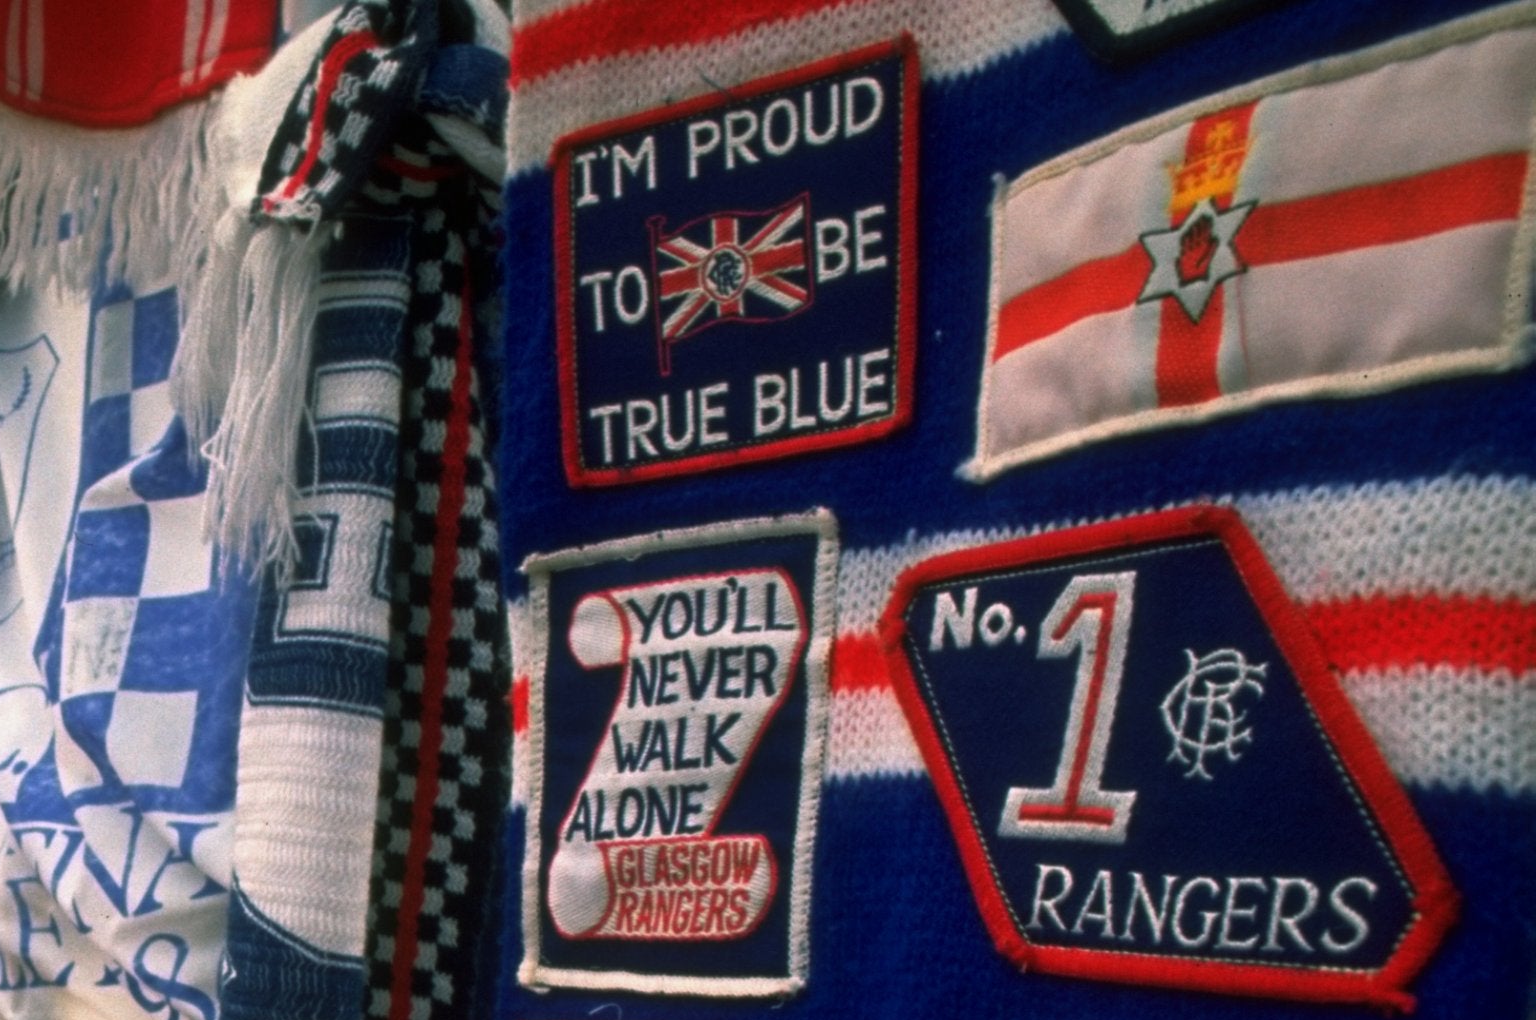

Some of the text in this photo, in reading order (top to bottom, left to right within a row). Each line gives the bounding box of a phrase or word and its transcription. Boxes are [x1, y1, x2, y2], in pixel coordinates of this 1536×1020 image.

[575, 77, 885, 207] I'M PROUD
[579, 265, 649, 332] TO
[814, 205, 889, 283] BE
[590, 348, 890, 463] TRUE BLUE
[628, 576, 795, 645] YOU'LL
[627, 645, 779, 708] NEVER
[928, 571, 1138, 845] No. 1
[611, 712, 742, 774] WALK
[565, 782, 710, 843] ALONE
[616, 841, 762, 888] GLASGOW
[615, 888, 750, 934] RANGERS
[1025, 862, 1379, 953] RANGERS
